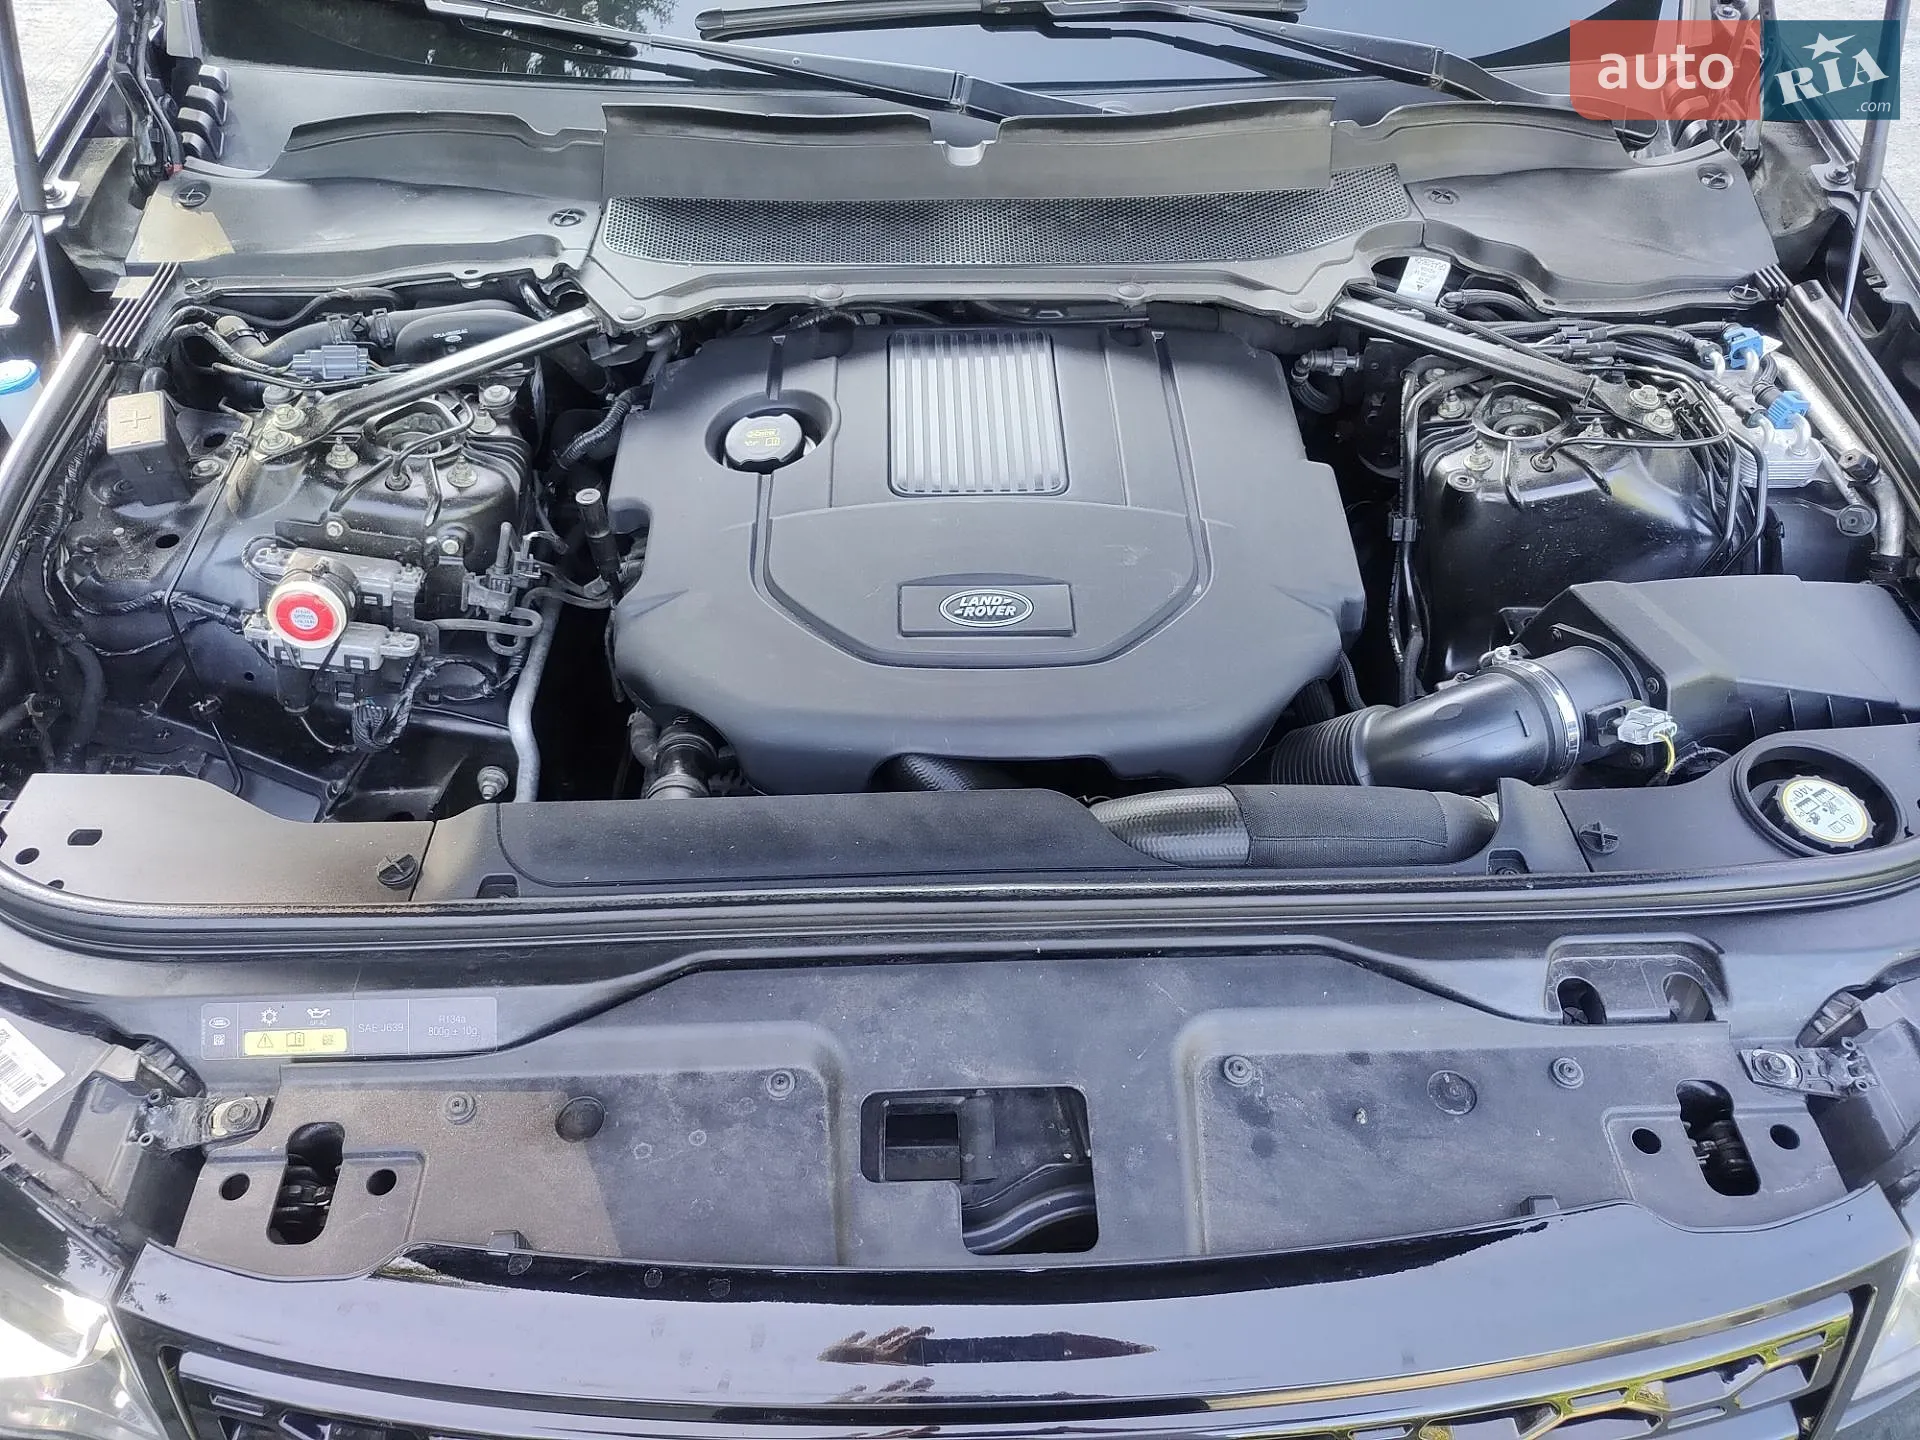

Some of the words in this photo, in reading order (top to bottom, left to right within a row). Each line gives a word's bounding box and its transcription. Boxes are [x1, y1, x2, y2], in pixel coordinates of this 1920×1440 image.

[959, 596, 1001, 607] LAND
[963, 606, 1016, 617] ROVER
[358, 1023, 378, 1033] SAE
[380, 1022, 404, 1033] J639
